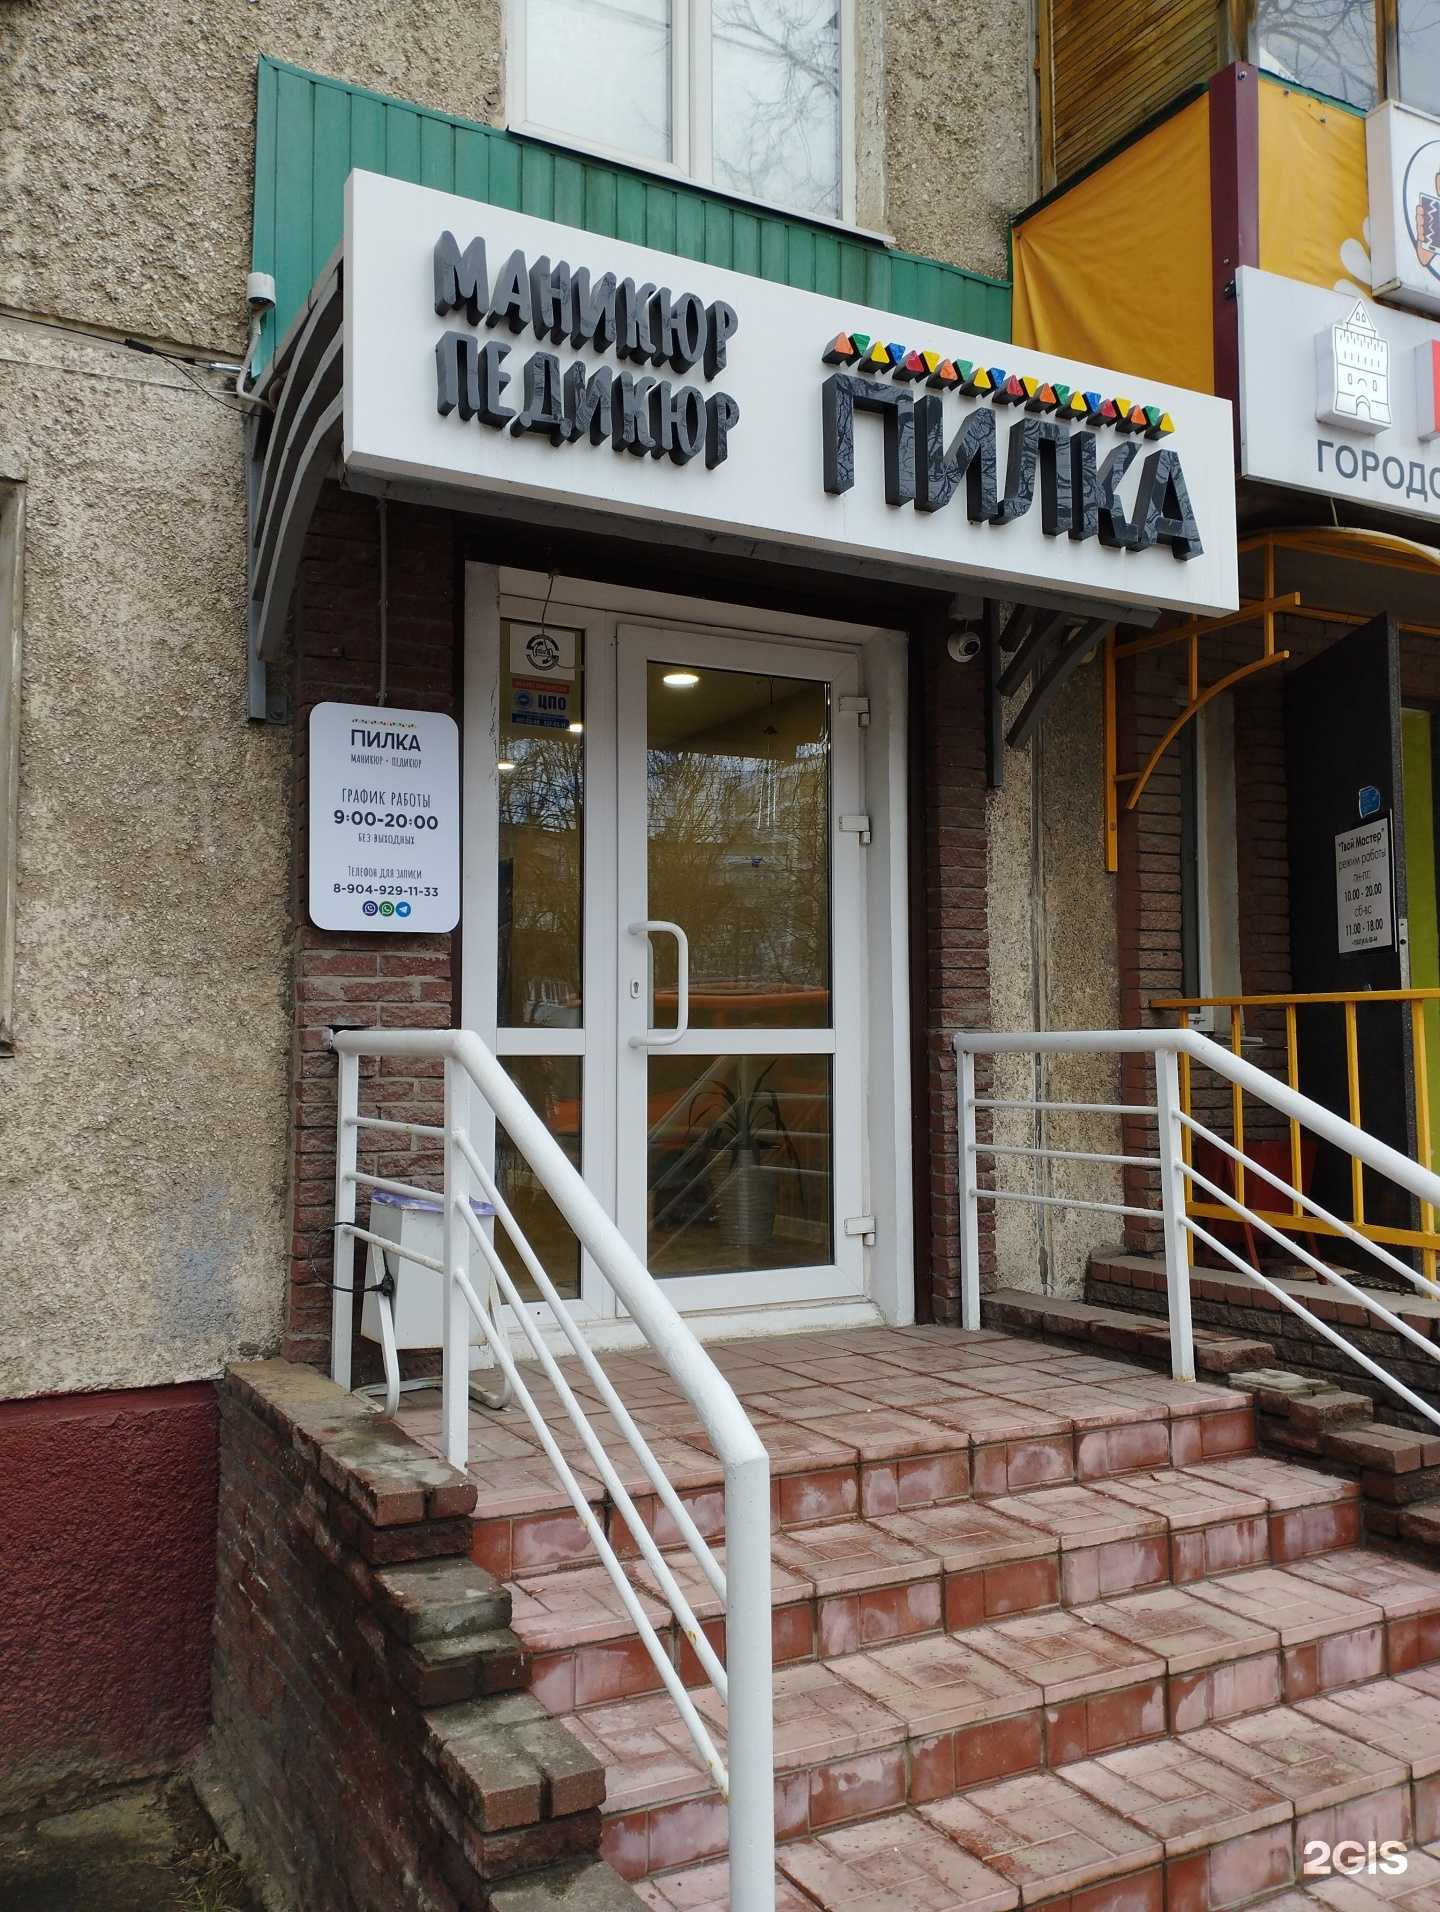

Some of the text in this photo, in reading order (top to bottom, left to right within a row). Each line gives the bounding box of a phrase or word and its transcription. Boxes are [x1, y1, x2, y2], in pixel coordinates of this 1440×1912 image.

[433, 230, 739, 381] МАНИКЮР
[435, 329, 740, 471] ПЕДИКЮР
[822, 372, 1203, 561] ПИЛКА
[350, 729, 421, 752] ПИЛКА
[350, 753, 383, 767] МАНИКЮР
[342, 788, 431, 808] ГРАФИК РАБОТЫ
[333, 809, 439, 830] 9:00-20:00
[358, 832, 415, 846] БЕЗ ВЫХОДНЫХ
[396, 868, 422, 880] ЗАПИСИ
[333, 883, 439, 897] 8-904-929-11-33
[1344, 887, 1360, 903] 10.00
[1365, 882, 1382, 898] 20.00
[1345, 922, 1361, 937] 11.00
